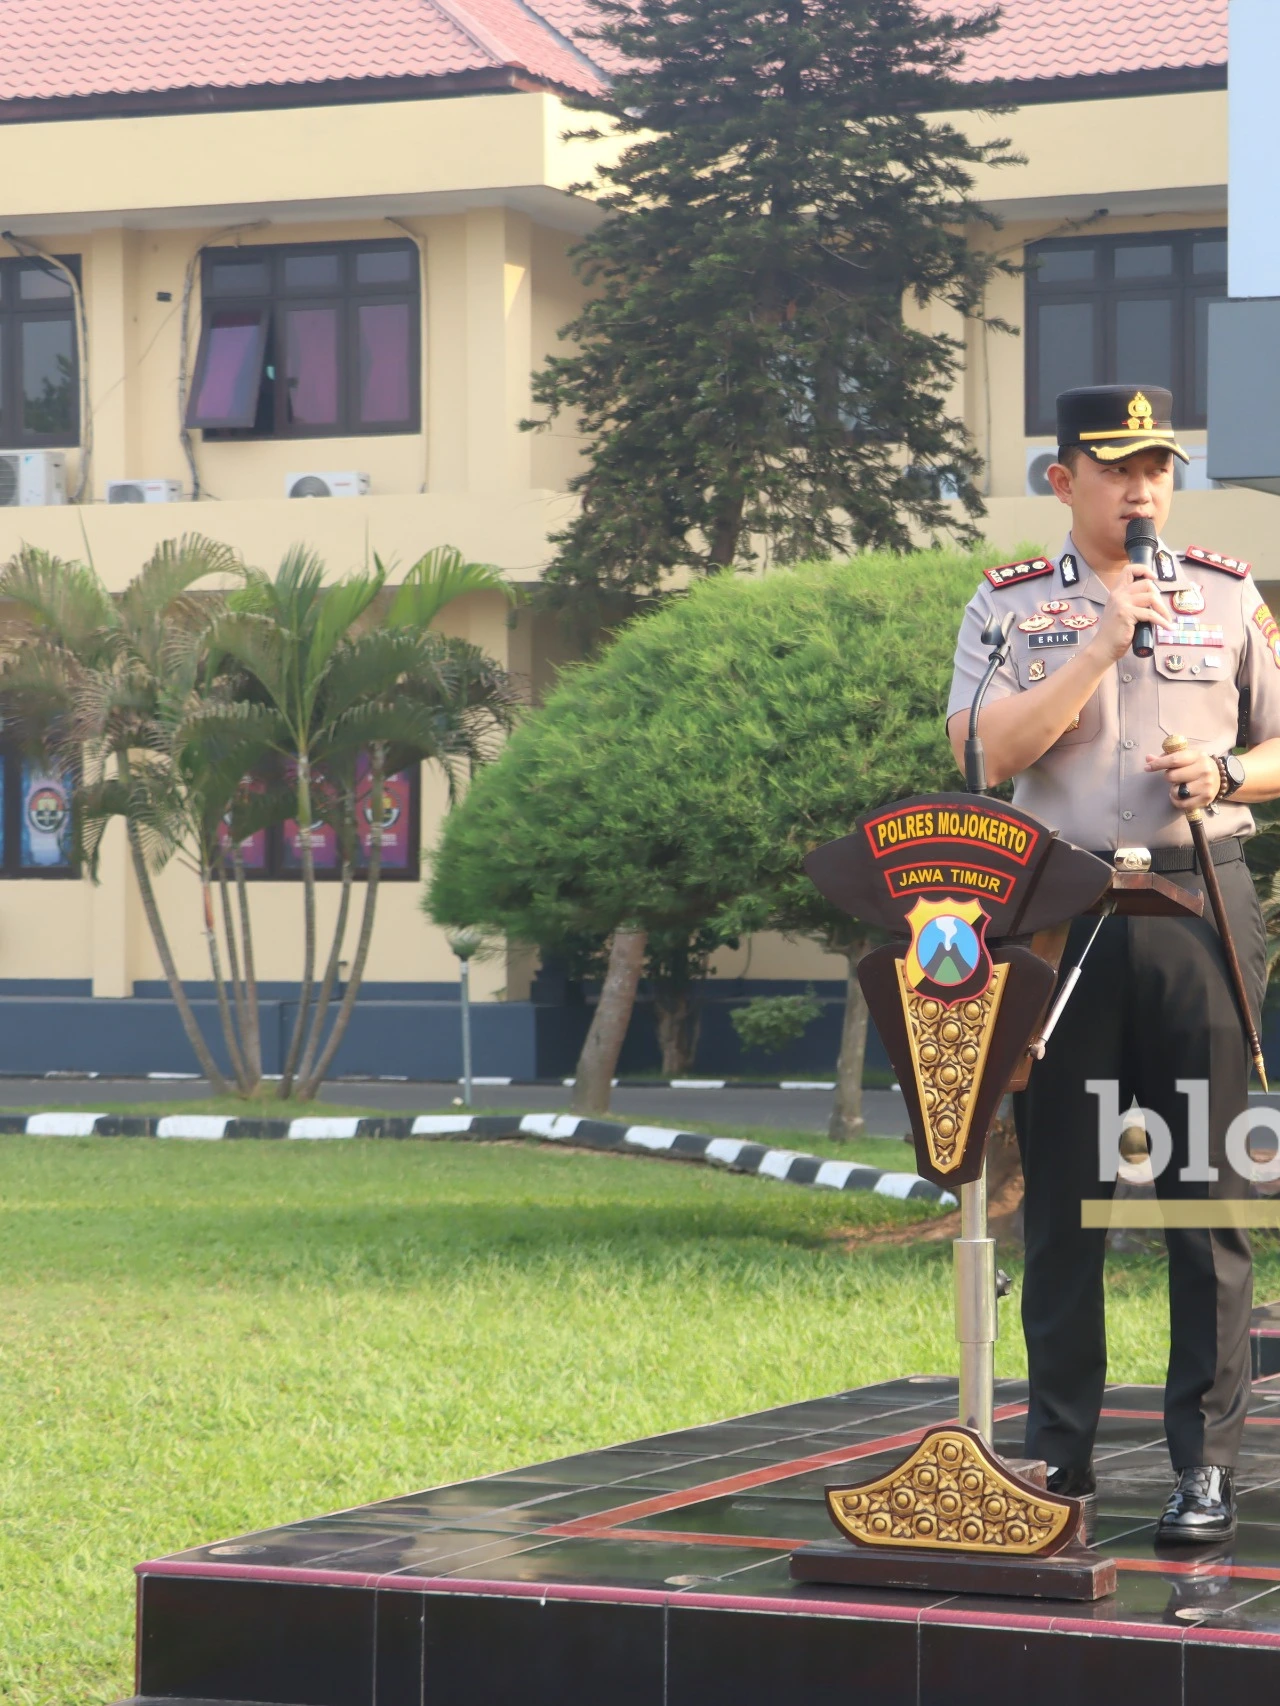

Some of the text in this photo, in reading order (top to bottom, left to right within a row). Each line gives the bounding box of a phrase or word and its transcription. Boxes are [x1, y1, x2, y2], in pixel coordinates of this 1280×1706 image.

[1038, 634, 1069, 644] ERIK
[877, 811, 1028, 854] POLRES MOJOKERTO
[899, 868, 1001, 893] JAWA TIMUR
